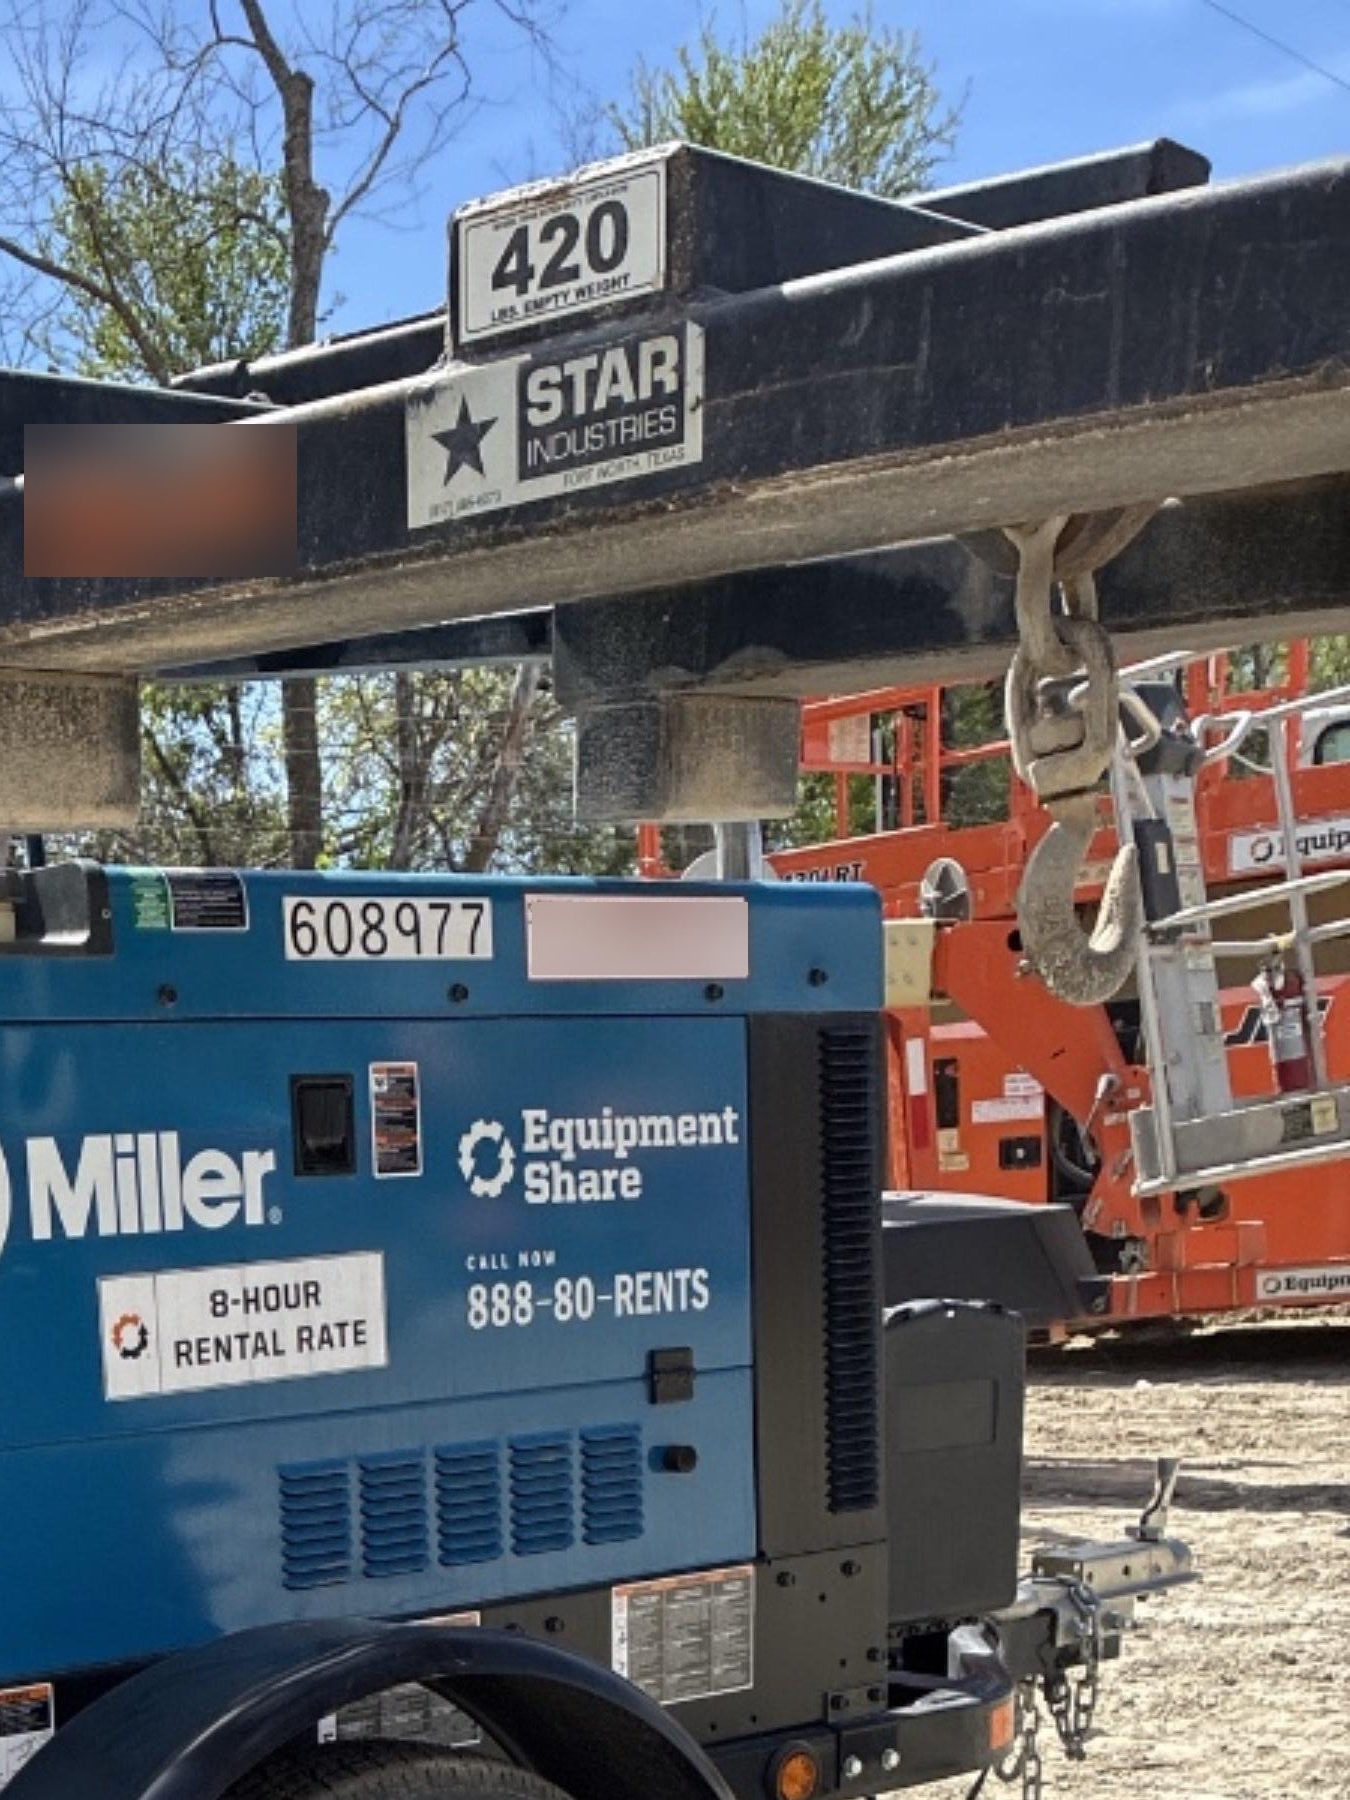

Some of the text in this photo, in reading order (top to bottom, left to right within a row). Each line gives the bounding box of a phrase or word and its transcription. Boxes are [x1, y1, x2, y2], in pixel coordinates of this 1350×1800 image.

[491, 200, 628, 297] 420
[524, 288, 571, 314] EMPTY
[575, 272, 631, 299] WEIGHT
[526, 335, 680, 427] STAR
[527, 404, 677, 467] INDUSTRIES
[289, 900, 486, 957] 608977
[521, 1104, 739, 1161] Equipment
[522, 1161, 644, 1204] Share
[465, 1249, 557, 1272] CALL NOW
[209, 1280, 321, 1318] 8-HOUR
[466, 1267, 710, 1331] 888-80-RENTS
[173, 1319, 368, 1368] RENTAL RATE
